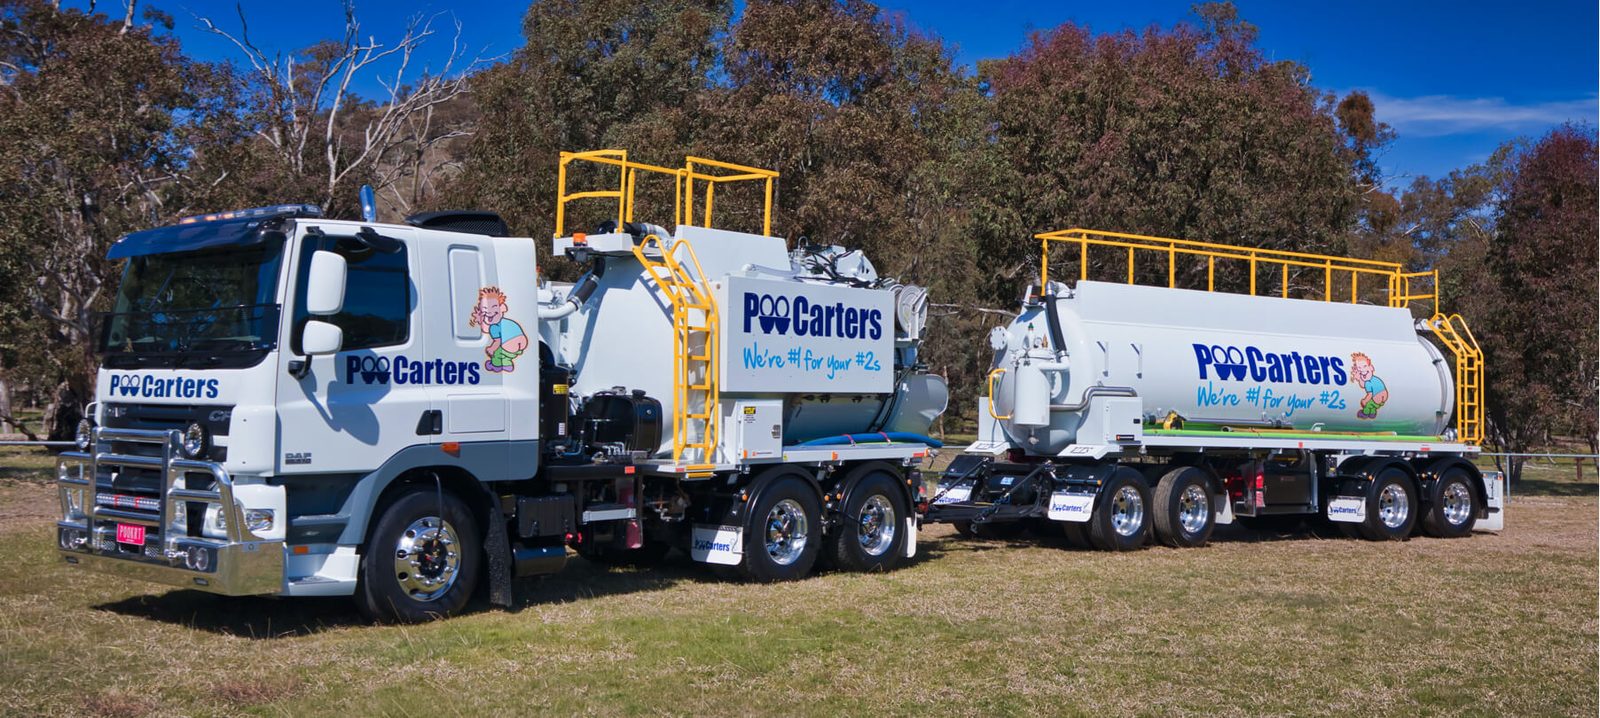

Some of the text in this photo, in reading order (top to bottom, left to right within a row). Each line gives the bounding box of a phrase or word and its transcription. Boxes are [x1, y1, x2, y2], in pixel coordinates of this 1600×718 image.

[743, 342, 881, 380] We're #1 for your #2s
[1197, 380, 1347, 417] We're #1 for your #2s
